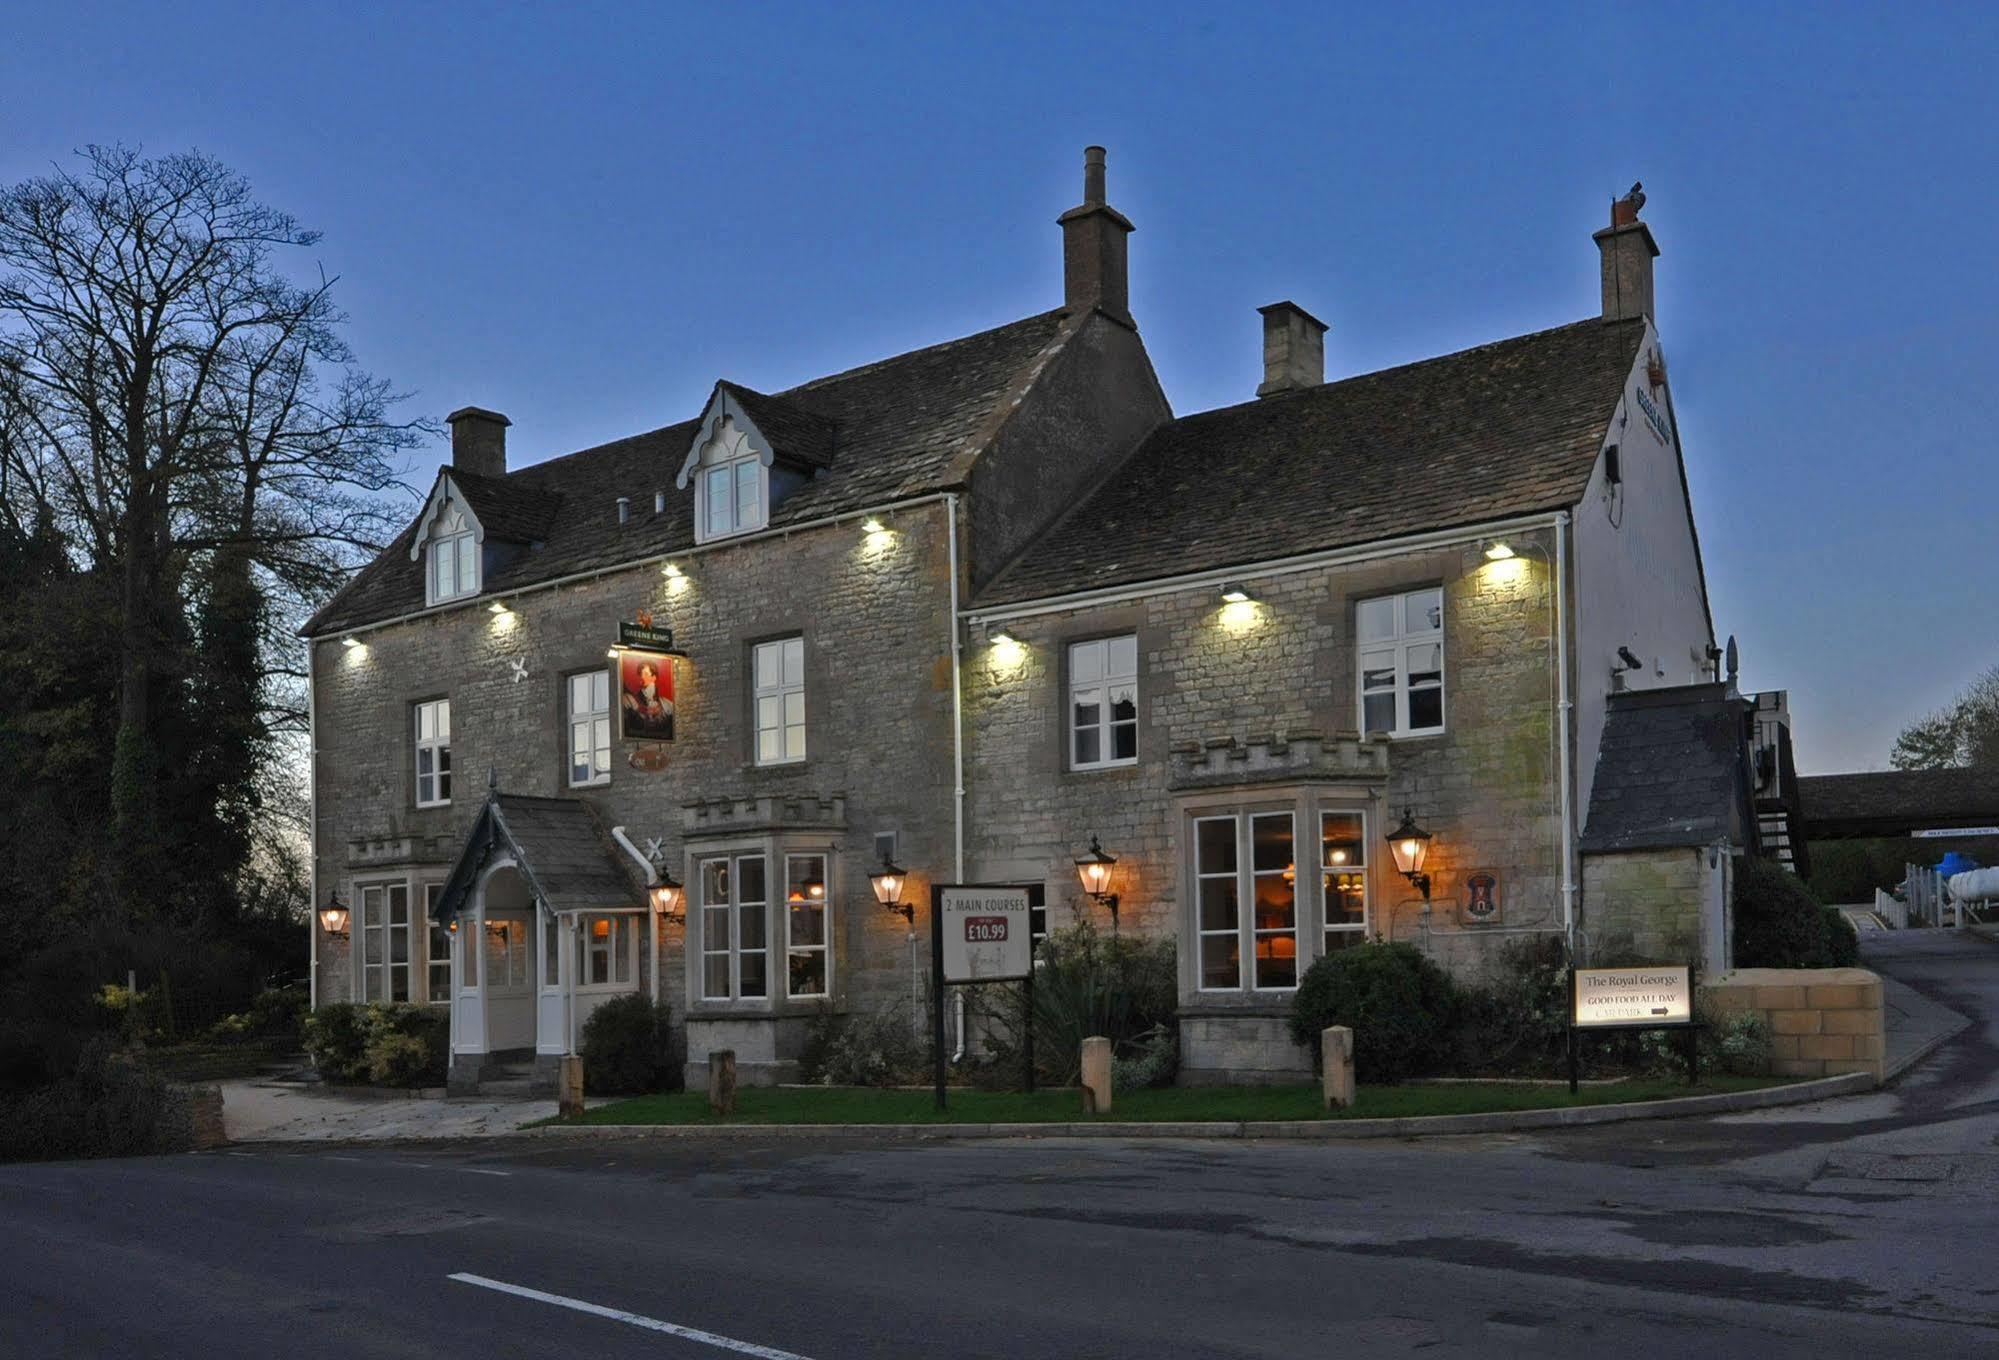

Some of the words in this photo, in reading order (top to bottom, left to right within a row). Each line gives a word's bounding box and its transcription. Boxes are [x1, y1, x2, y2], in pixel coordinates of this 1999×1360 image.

[946, 898, 952, 912] 2
[956, 899, 981, 911] MAIN
[985, 899, 1025, 911] COURSES
[968, 925, 1005, 940] £10.99
[1587, 977, 1606, 987] The
[1609, 975, 1637, 988] Royal
[1640, 974, 1678, 987] George
[1588, 997, 1613, 1005] GOOD
[1615, 996, 1639, 1004] FOOD
[1642, 995, 1657, 1003] ALL
[1659, 994, 1676, 1002] DAY
